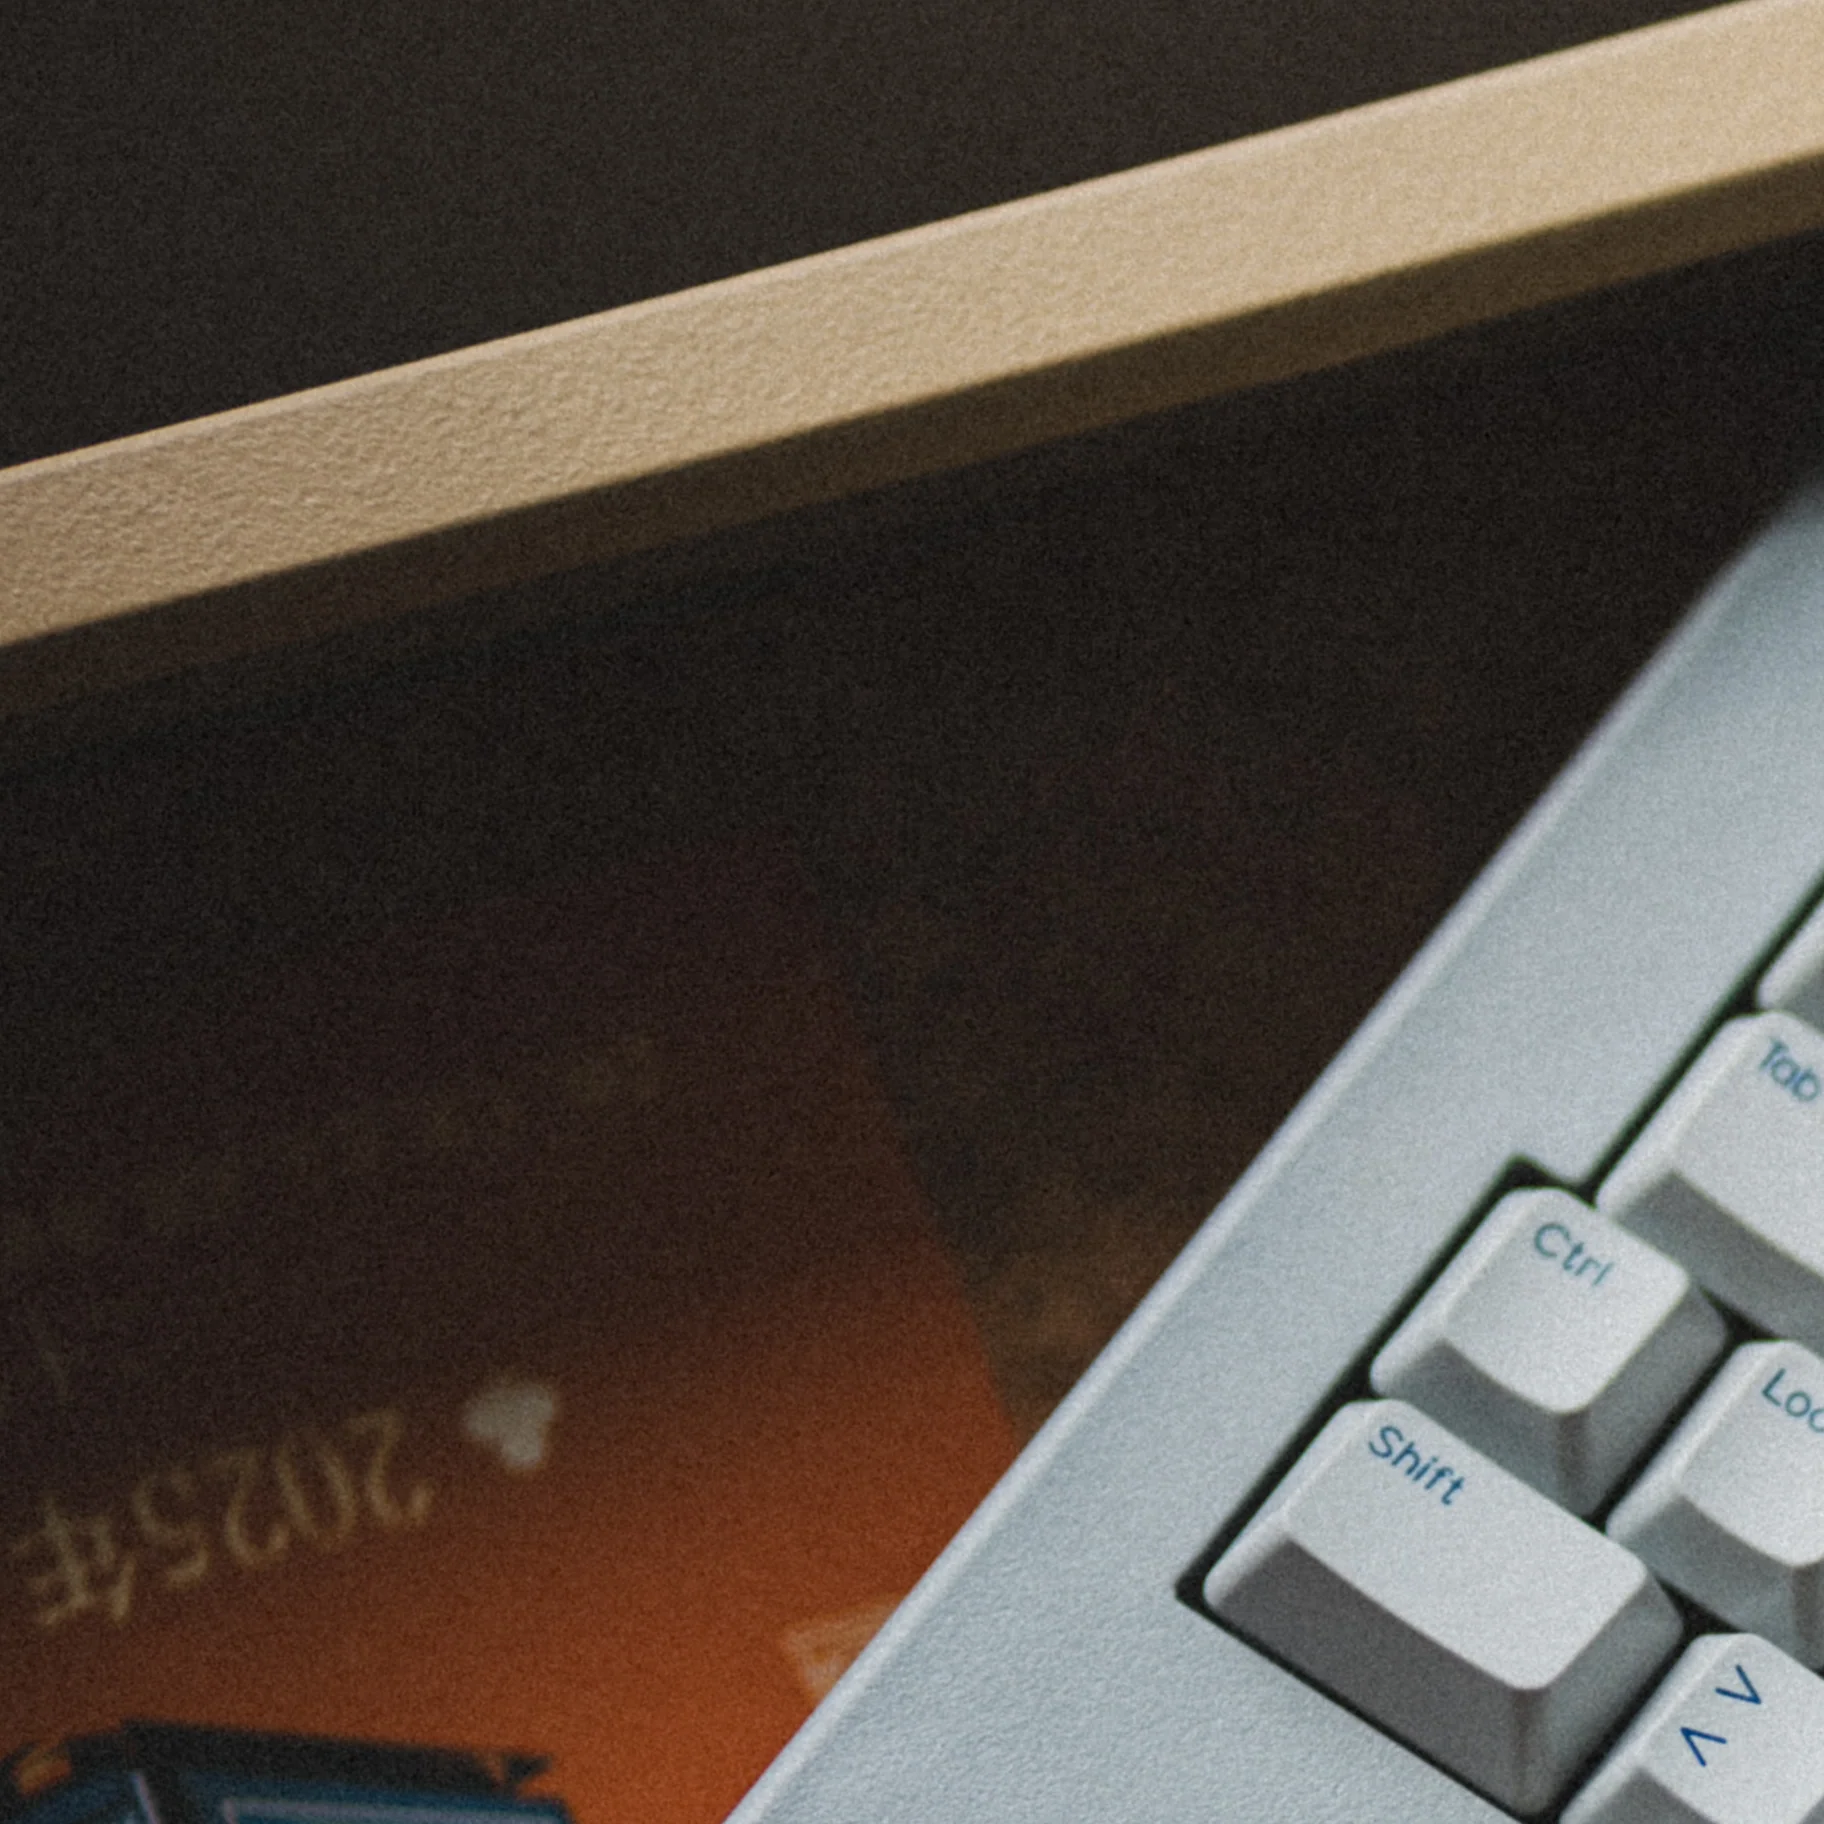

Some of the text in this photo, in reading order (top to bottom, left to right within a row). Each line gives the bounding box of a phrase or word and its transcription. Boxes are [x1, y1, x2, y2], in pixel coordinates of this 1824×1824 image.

[1759, 1038, 1821, 1102] Tab
[1532, 1221, 1612, 1285] Ctrl
[1368, 1425, 1464, 1506] Shift
